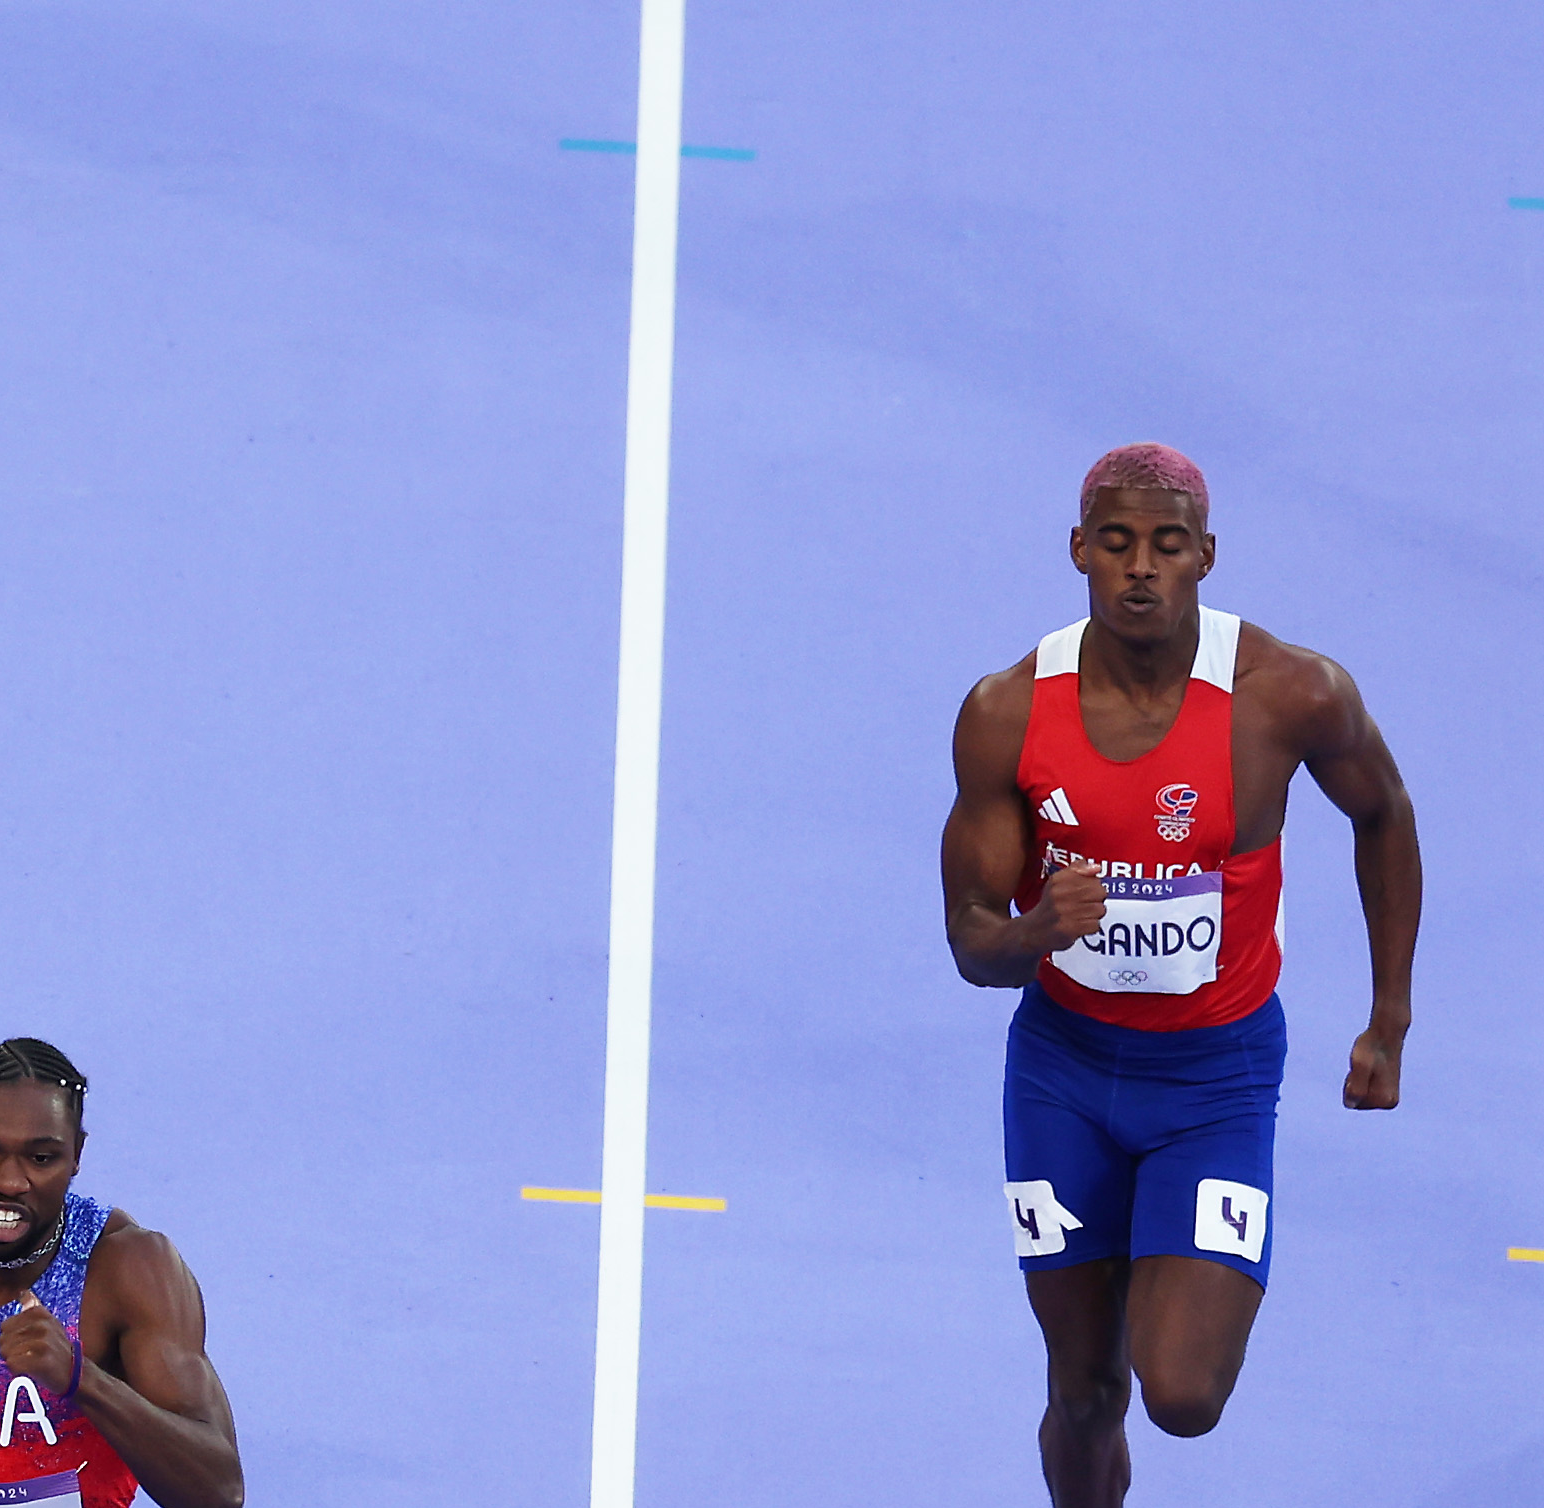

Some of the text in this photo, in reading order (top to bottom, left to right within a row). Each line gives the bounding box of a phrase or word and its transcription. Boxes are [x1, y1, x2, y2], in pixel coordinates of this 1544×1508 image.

[1132, 883, 1173, 895] 2024
[1082, 916, 1215, 957] GANDO
[1014, 1198, 1040, 1240] 4
[1221, 1196, 1247, 1242] 4
